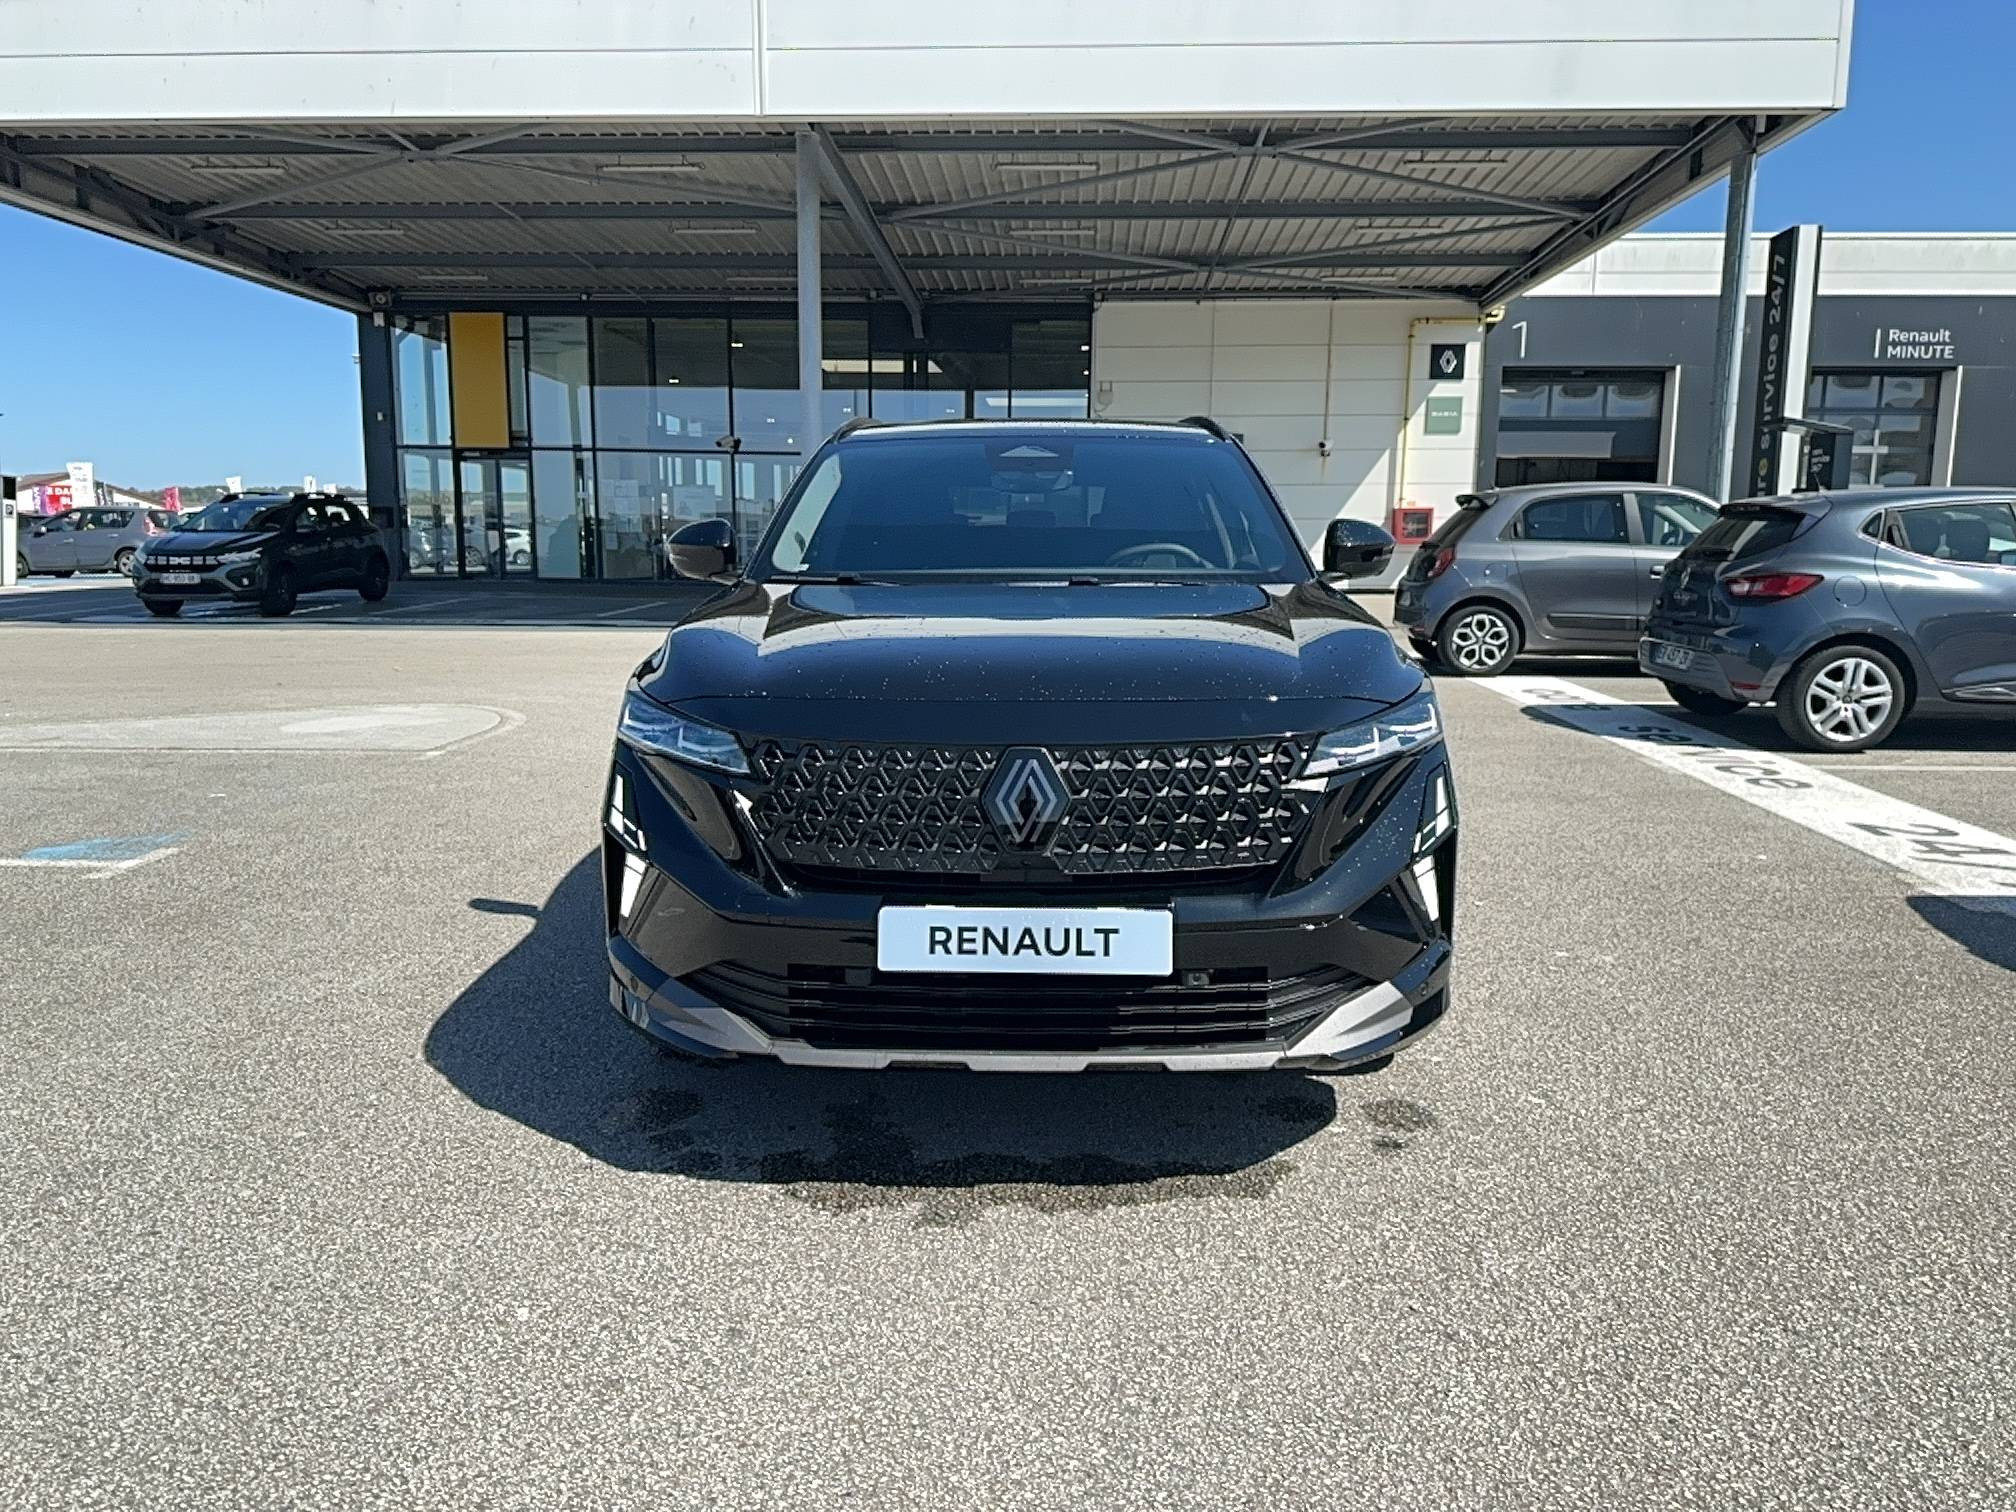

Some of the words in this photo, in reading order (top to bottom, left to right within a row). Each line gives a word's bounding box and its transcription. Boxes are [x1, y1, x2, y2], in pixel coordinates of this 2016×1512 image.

[1769, 254, 1786, 326] 24/7
[1888, 328, 1951, 343] Renault
[1887, 345, 1955, 359] MINUTE
[1846, 822, 2016, 888] 24/
[927, 926, 1120, 958] RENAULT
